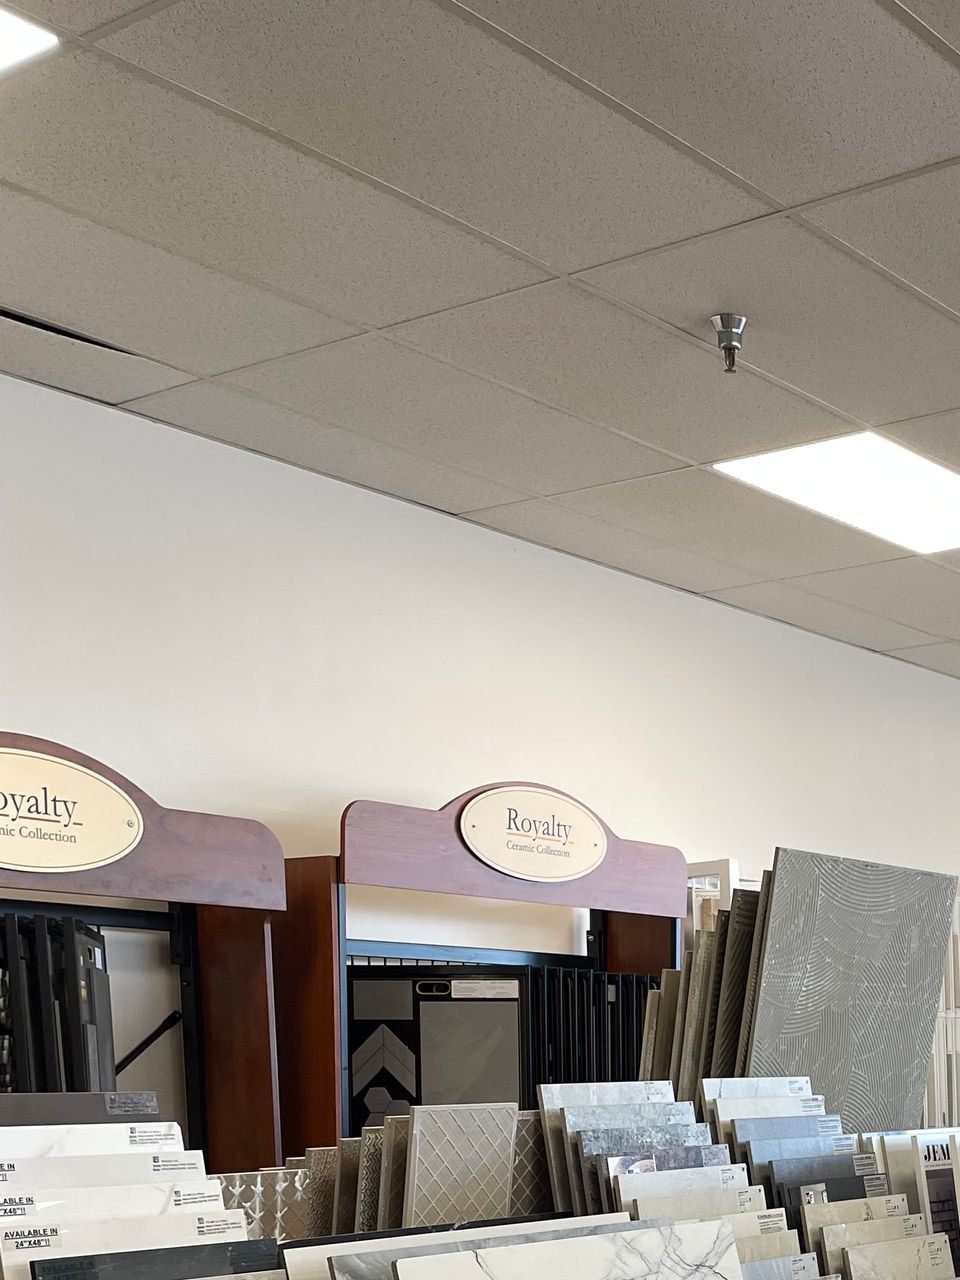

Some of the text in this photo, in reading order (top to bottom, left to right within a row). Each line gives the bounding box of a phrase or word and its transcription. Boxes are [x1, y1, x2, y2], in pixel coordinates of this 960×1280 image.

[0, 787, 78, 827] yalty
[19, 826, 77, 844] Collection
[506, 807, 572, 846] Royalty
[506, 840, 570, 858] Ceramic Collection
[924, 1143, 951, 1162] JEM
[4, 1228, 58, 1240] AVAILABLE IN
